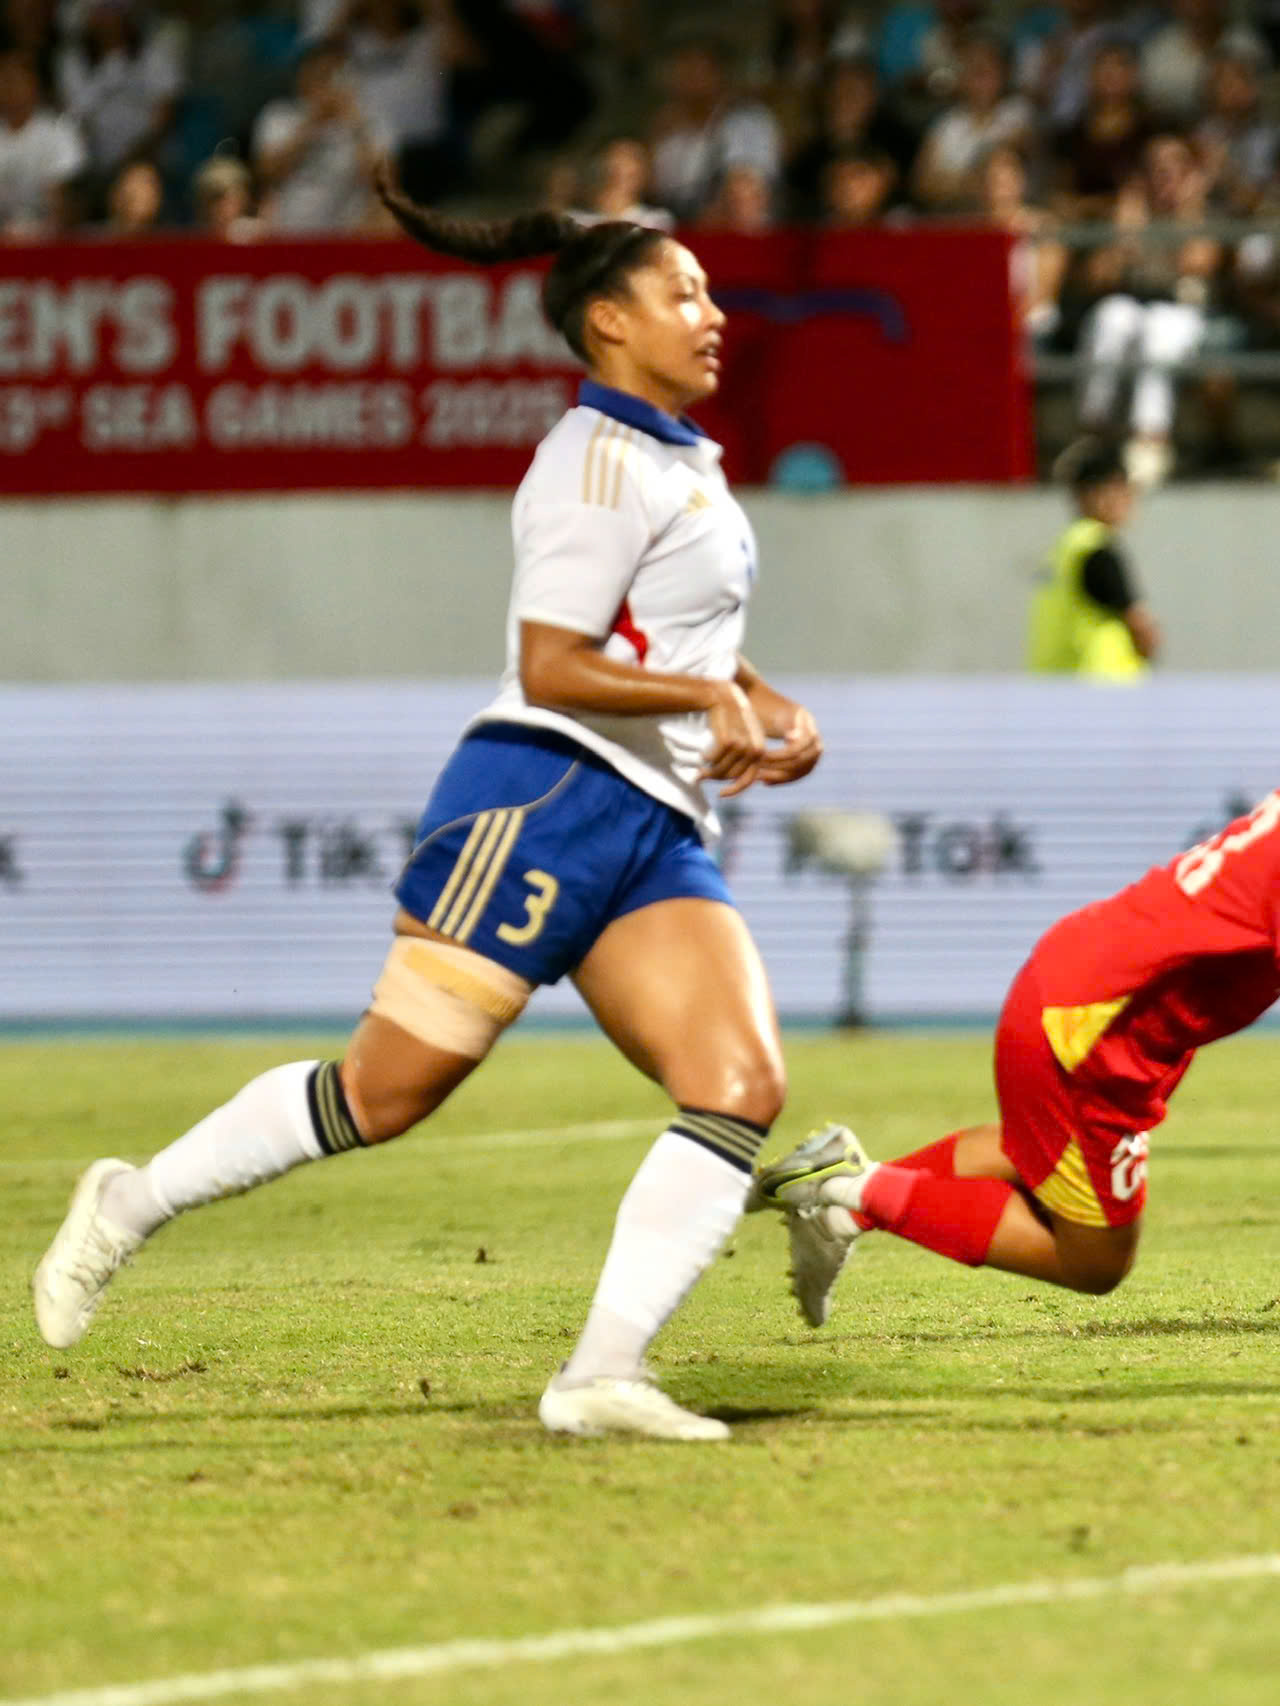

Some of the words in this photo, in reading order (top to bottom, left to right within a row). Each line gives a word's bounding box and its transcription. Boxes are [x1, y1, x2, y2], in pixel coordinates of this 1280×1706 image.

[83, 383, 195, 451] SEA
[208, 380, 411, 450] GAMES
[496, 869, 559, 946] 3
